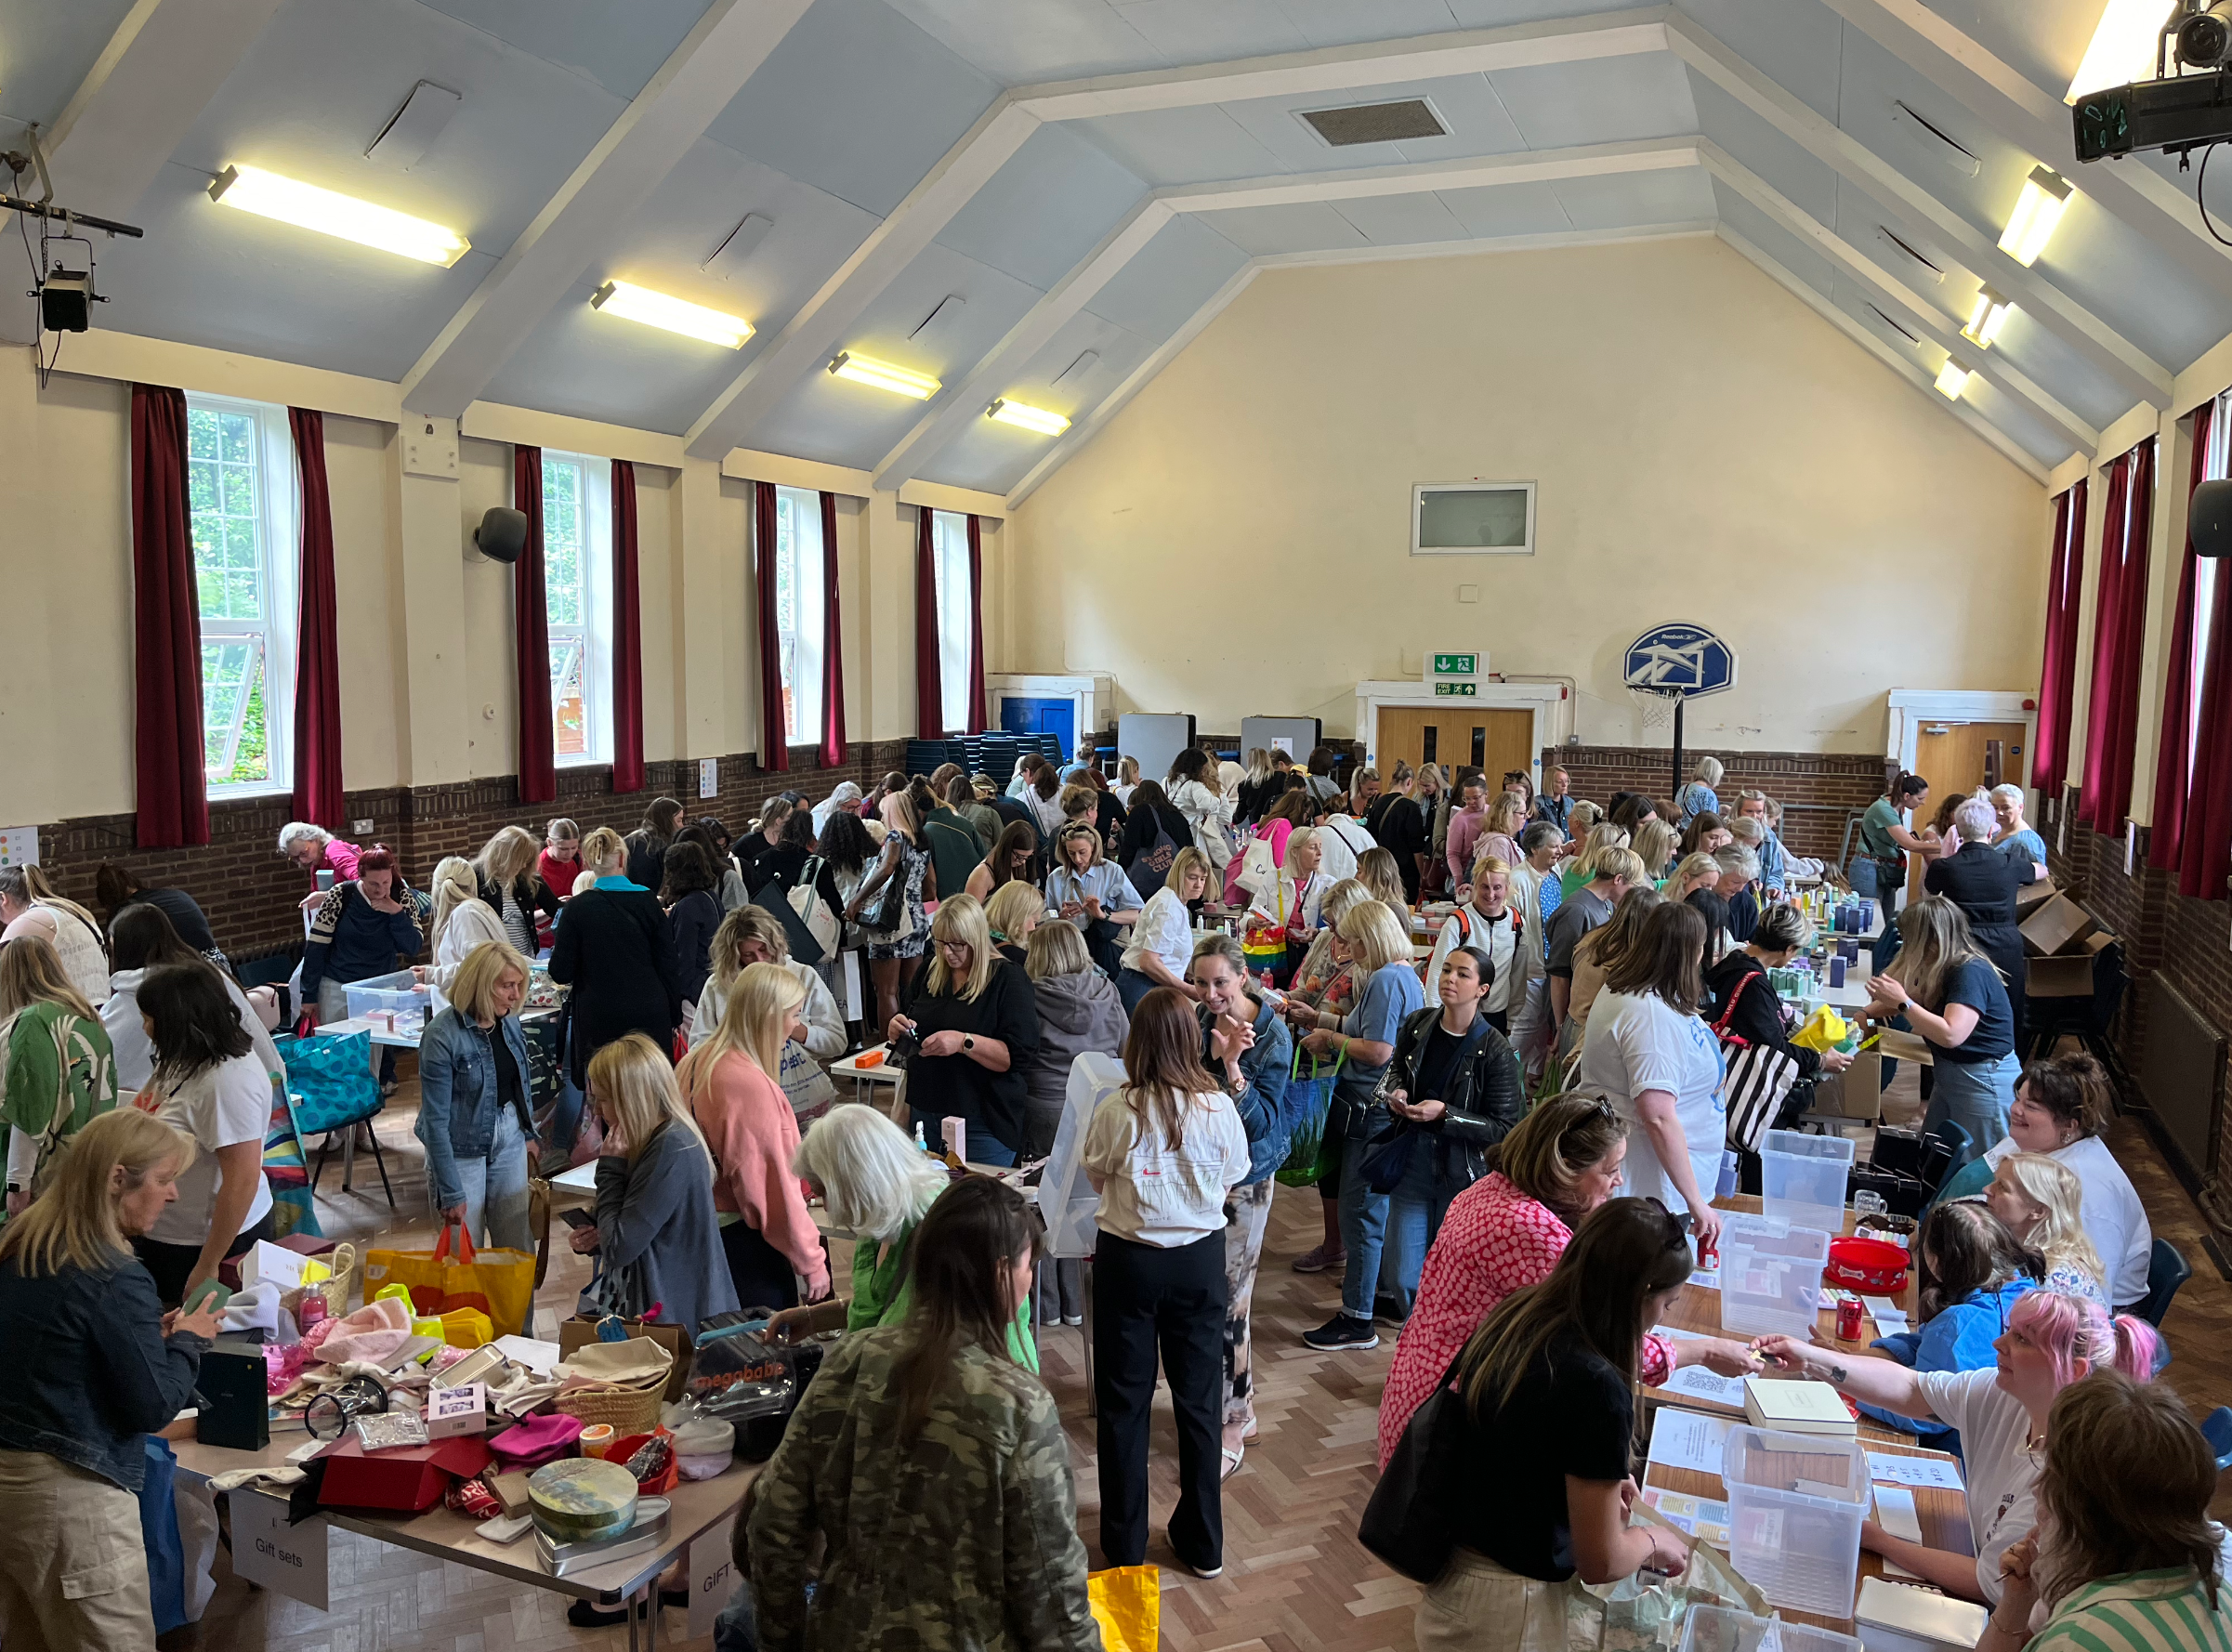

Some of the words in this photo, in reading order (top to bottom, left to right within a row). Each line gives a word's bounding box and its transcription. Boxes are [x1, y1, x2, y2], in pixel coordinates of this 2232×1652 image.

[695, 1359, 786, 1393] megababe
[256, 1538, 276, 1558] Gift
[278, 1550, 303, 1568] sets
[703, 1561, 731, 1593] GIFT
